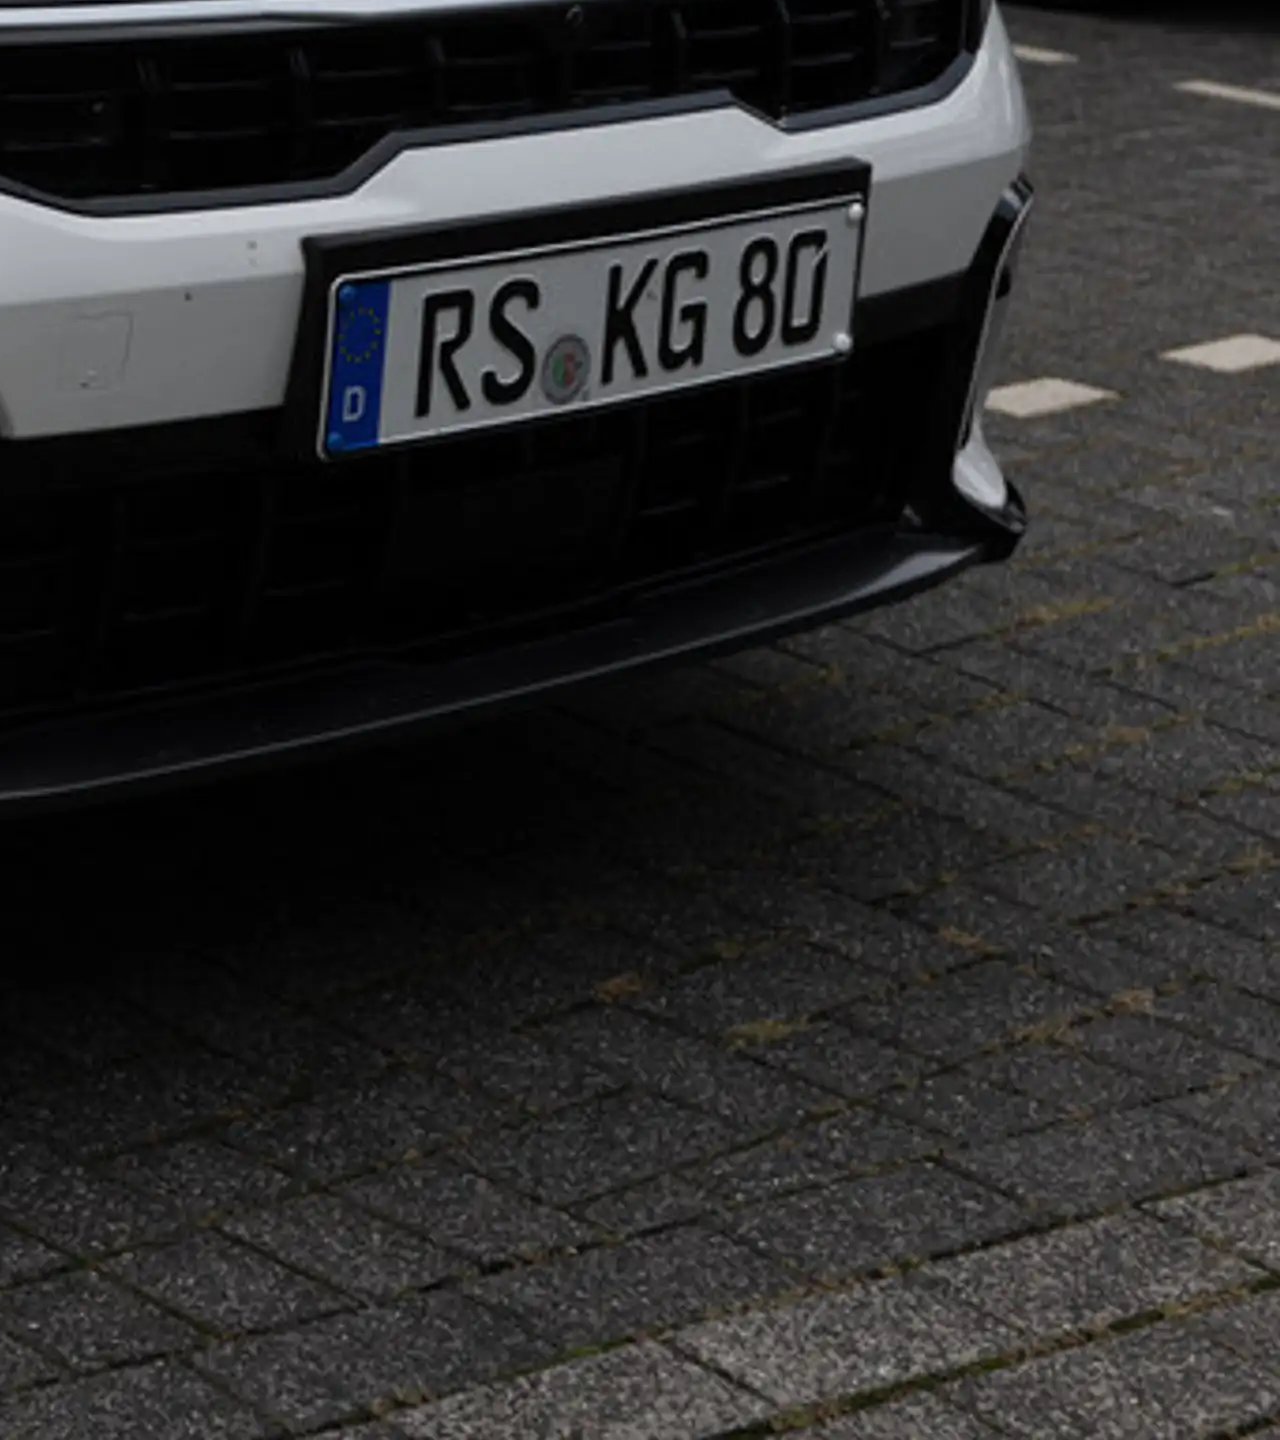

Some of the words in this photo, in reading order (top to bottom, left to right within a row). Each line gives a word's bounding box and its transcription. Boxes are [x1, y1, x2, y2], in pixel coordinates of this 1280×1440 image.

[414, 278, 541, 418] RS
[600, 249, 710, 385] KG
[732, 228, 829, 356] 80
[341, 385, 367, 423] D
